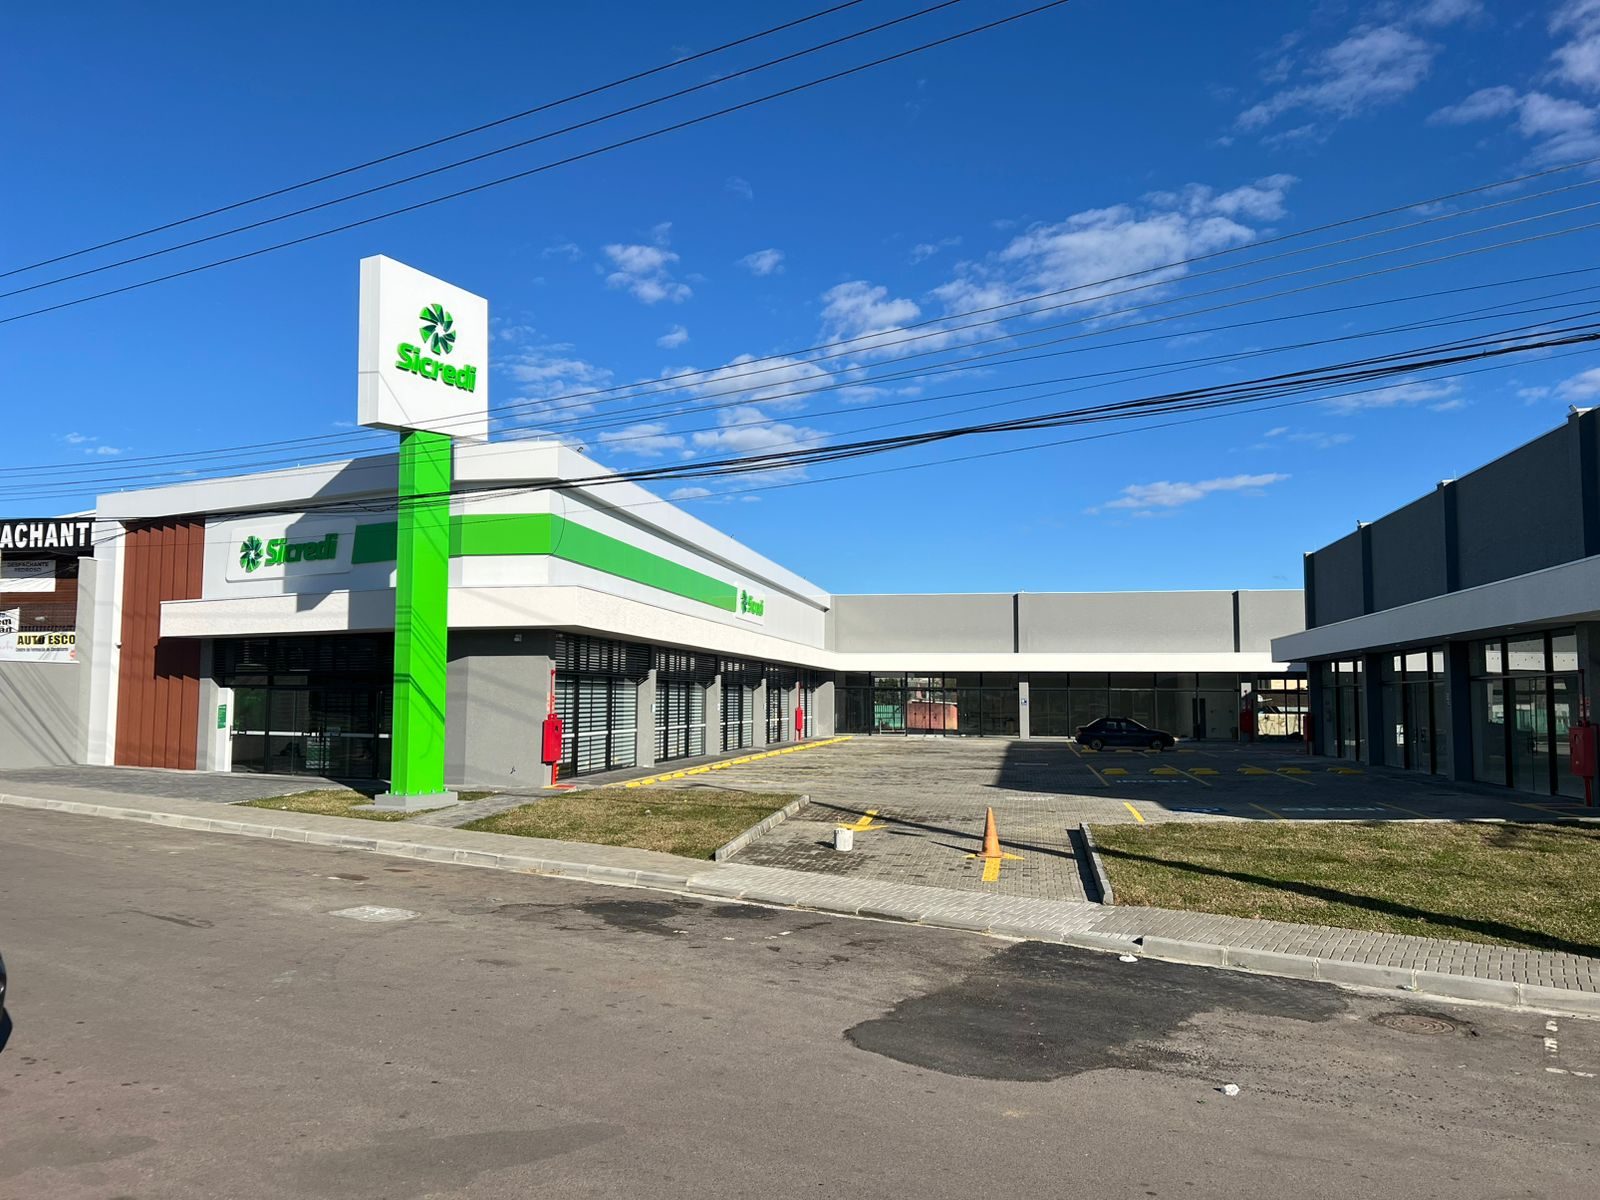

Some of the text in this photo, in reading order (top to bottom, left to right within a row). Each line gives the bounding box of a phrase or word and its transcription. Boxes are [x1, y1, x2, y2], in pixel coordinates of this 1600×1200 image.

[396, 342, 477, 393] Sicredi
[265, 533, 338, 567] Sicredi
[48, 635, 76, 645] ESCO
